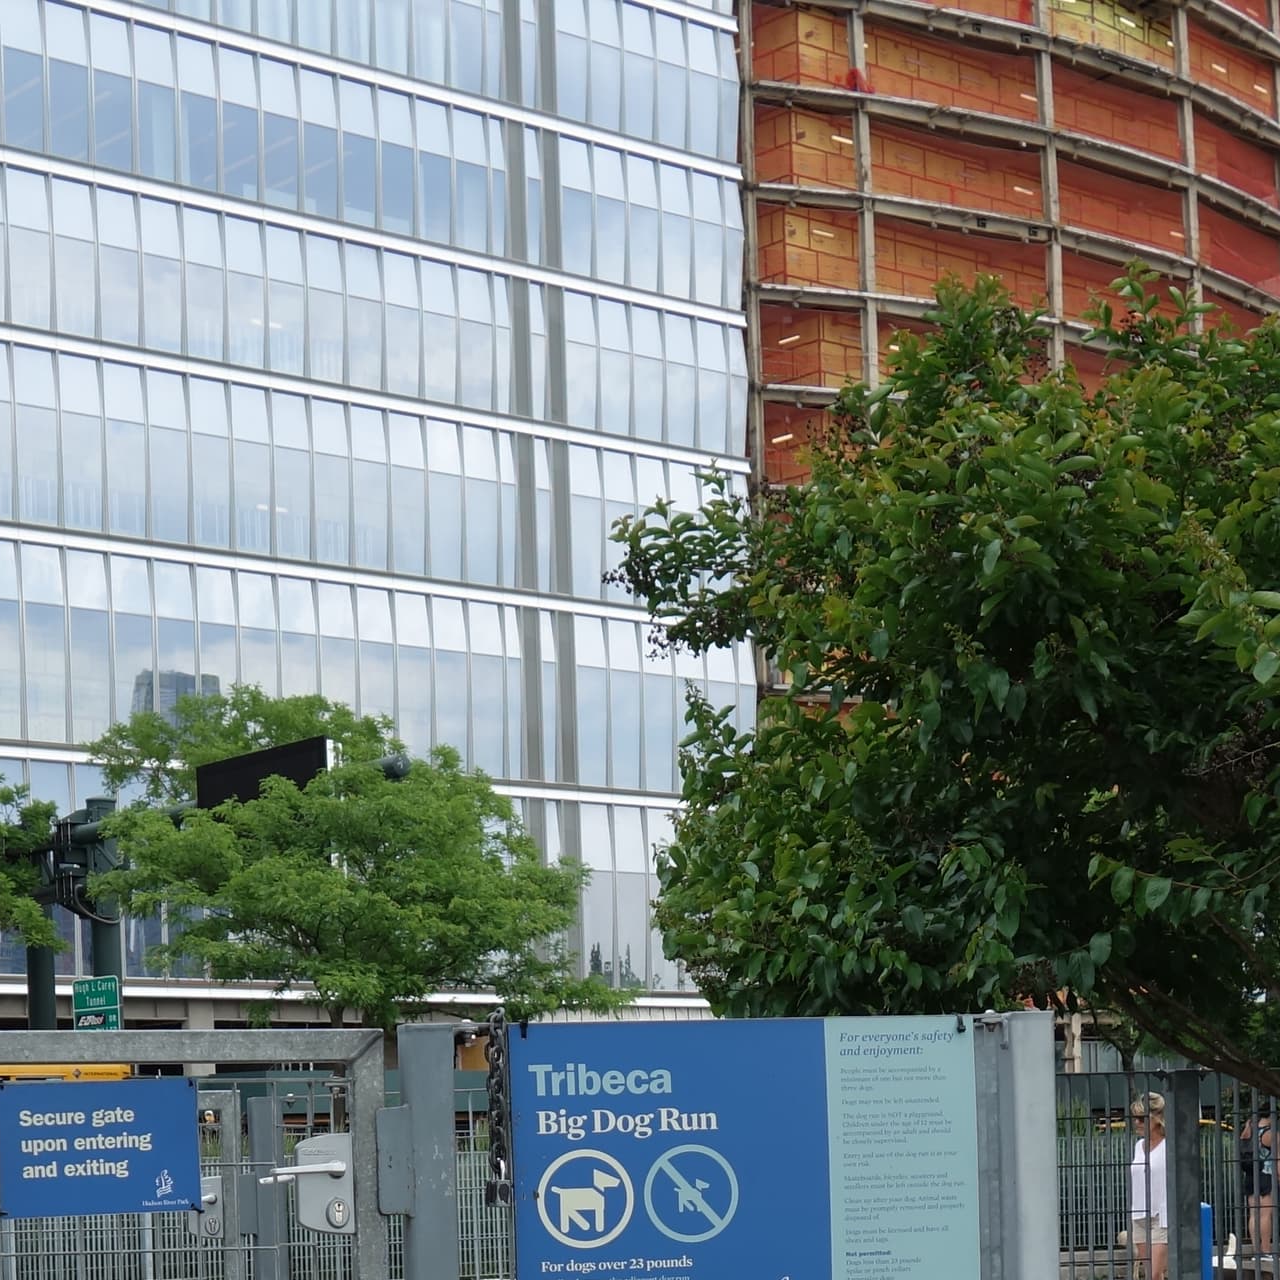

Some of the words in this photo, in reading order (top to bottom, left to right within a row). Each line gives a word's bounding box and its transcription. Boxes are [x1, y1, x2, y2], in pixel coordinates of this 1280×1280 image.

[75, 983, 89, 994] Hugh
[98, 981, 115, 992] Carey
[86, 996, 106, 1006] Tunnel
[840, 1033, 860, 1042] For
[862, 1032, 919, 1043] everyone's
[922, 1030, 954, 1043] safety
[840, 1046, 860, 1056] and
[864, 1046, 923, 1057] enjoyment:
[528, 1064, 672, 1096] Tribeca
[18, 1109, 85, 1127] Secure
[91, 1106, 135, 1127] gate
[537, 1109, 586, 1141] Big
[591, 1108, 652, 1139] Dog
[658, 1106, 718, 1131] Run
[21, 1138, 67, 1155] upon
[74, 1132, 152, 1152] entering
[22, 1160, 57, 1179] and
[64, 1157, 129, 1178] exiting
[541, 1261, 564, 1273] For
[566, 1260, 596, 1274] dogs
[598, 1260, 627, 1270] over
[629, 1258, 643, 1269] 23
[647, 1255, 693, 1271] pounds
